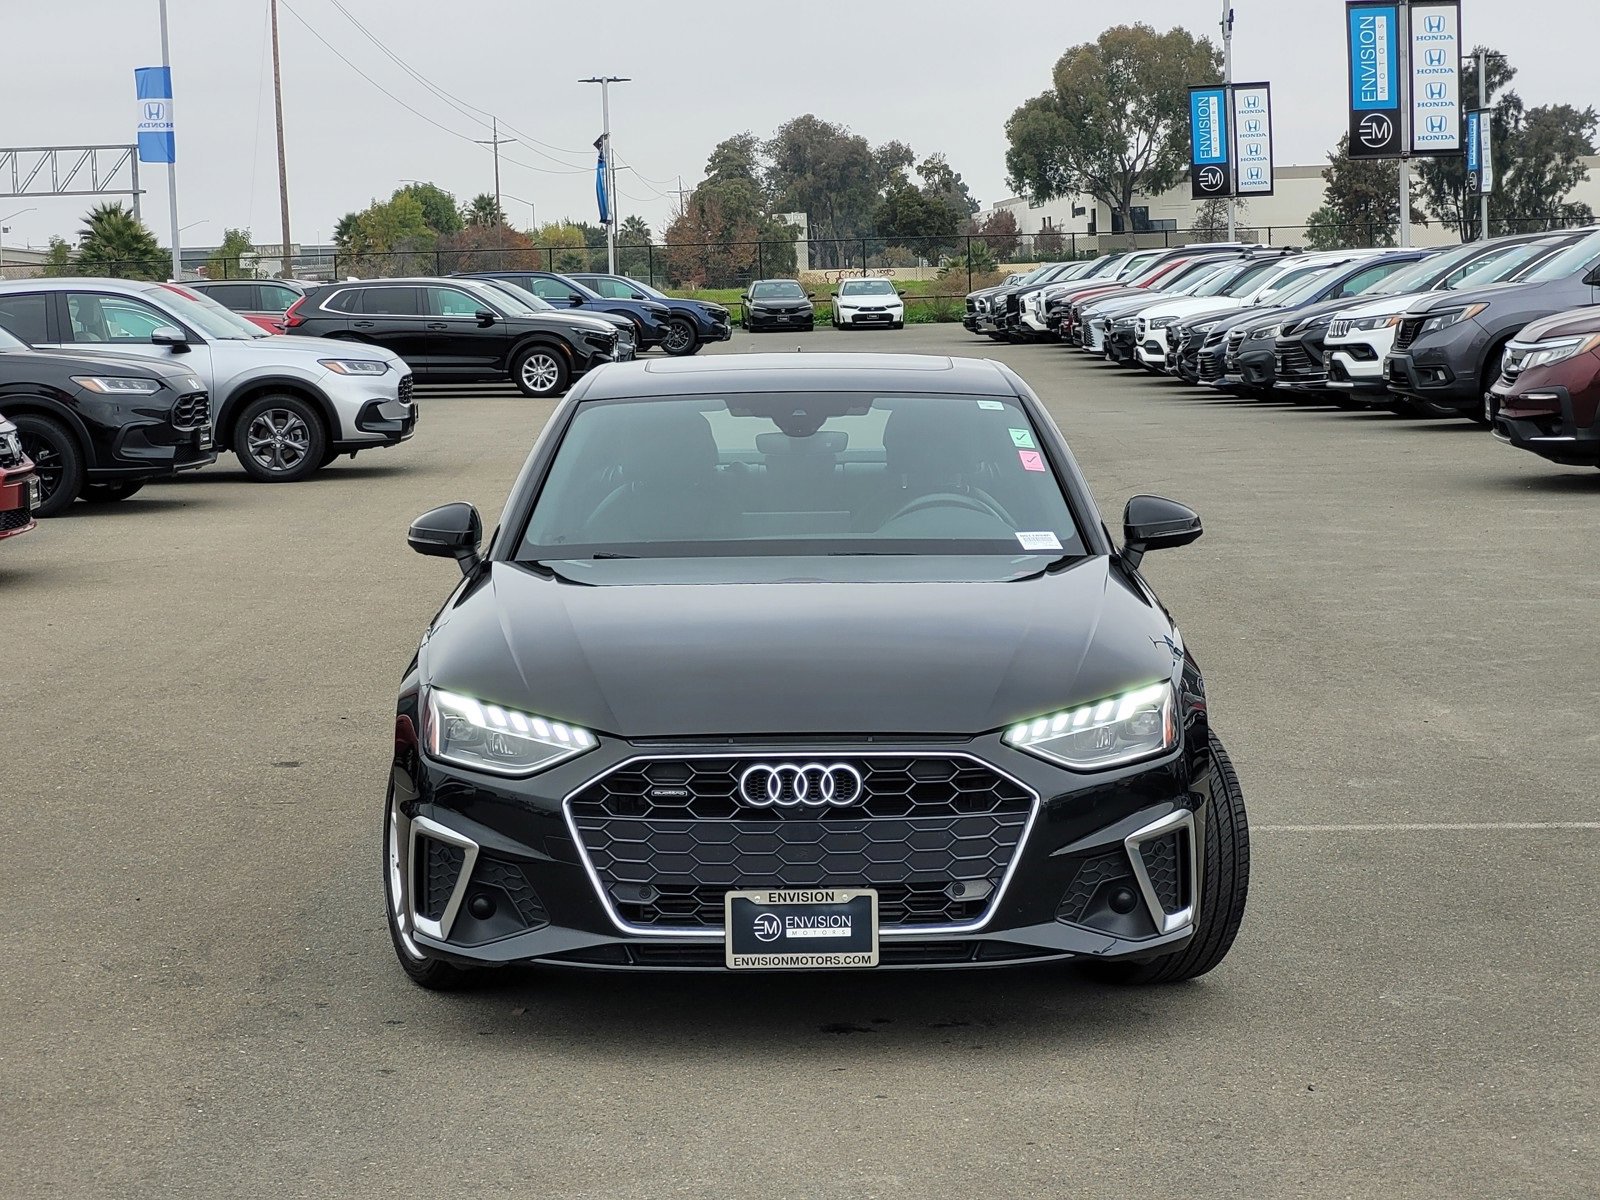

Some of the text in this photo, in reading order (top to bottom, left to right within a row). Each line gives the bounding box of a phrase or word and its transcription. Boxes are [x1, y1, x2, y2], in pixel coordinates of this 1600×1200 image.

[1359, 16, 1376, 102] ENVISION
[1378, 24, 1386, 94] MOTORS
[1197, 96, 1211, 159] ENVISION
[768, 891, 835, 903] ENVISION
[785, 915, 852, 928] ENVISION
[733, 955, 872, 966] ENVISIONMOTORS.COM
